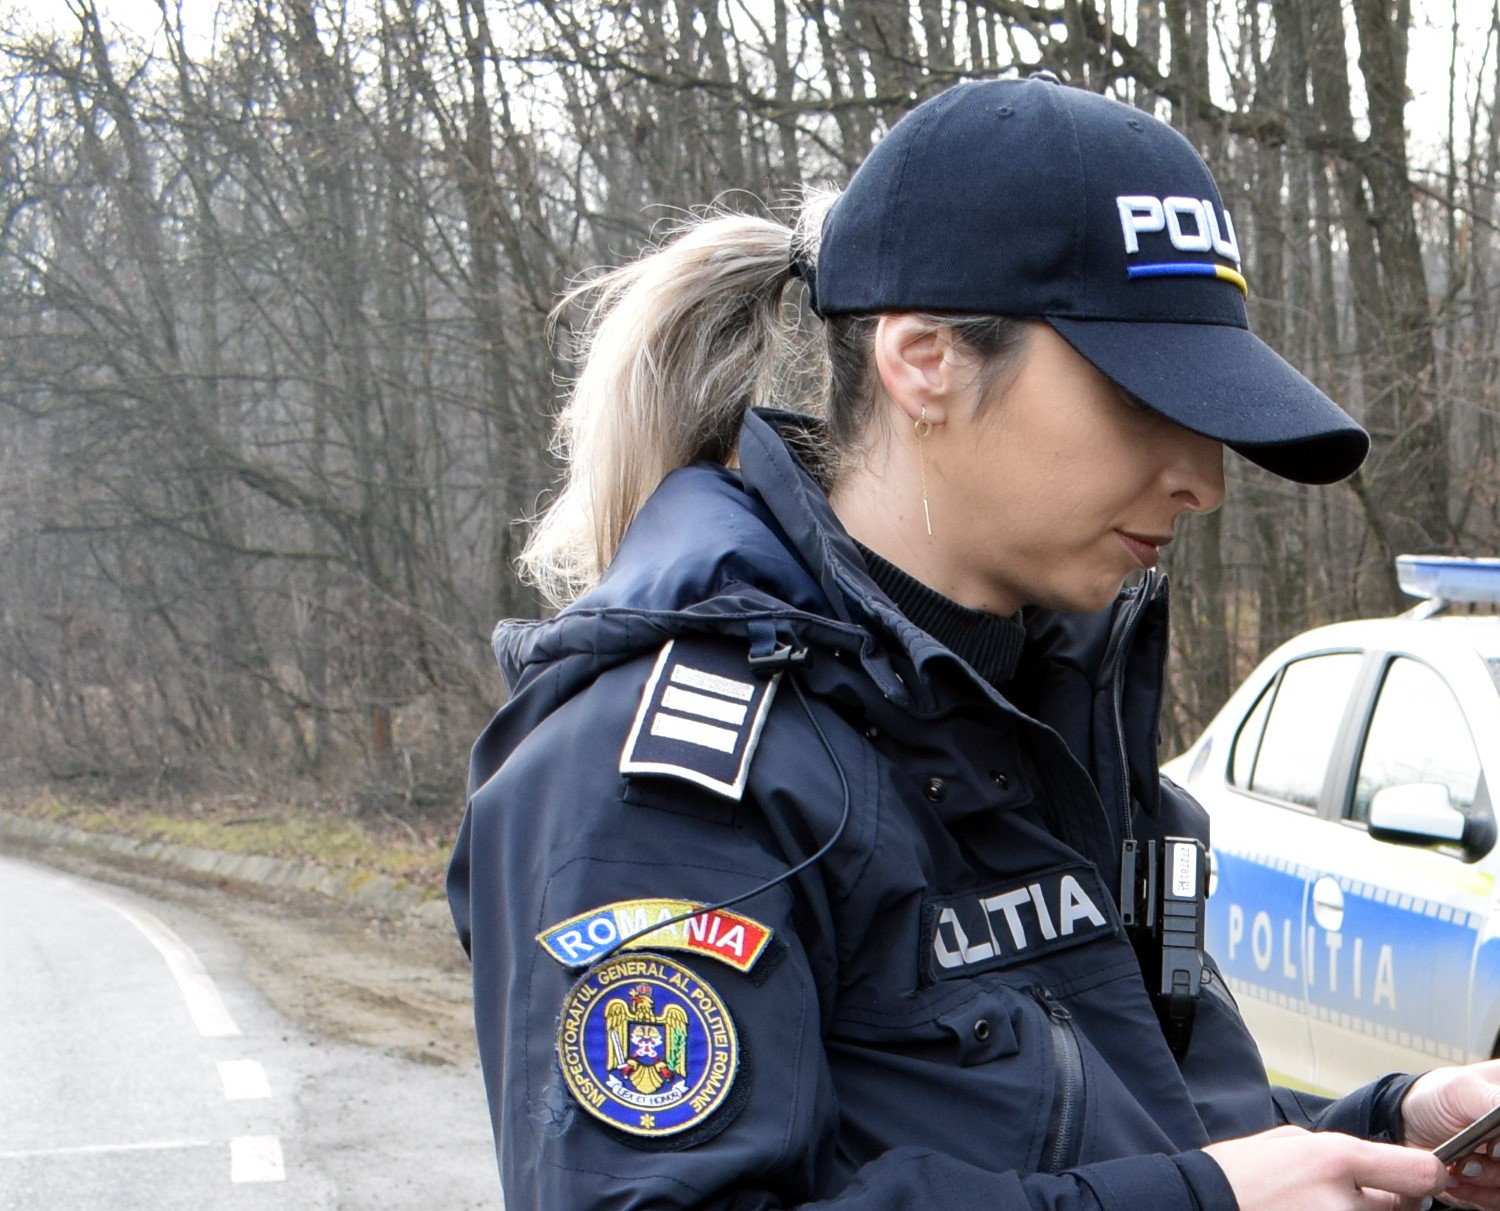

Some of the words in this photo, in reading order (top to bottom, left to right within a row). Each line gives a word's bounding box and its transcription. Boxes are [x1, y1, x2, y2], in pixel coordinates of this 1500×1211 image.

[556, 907, 746, 958] ROMANIA
[1228, 904, 1397, 1010] POLITIA
[564, 983, 607, 1108] INSPECTORATUL
[597, 961, 669, 985] GENERAL
[669, 972, 691, 993] AL
[616, 1087, 633, 1101] LEX
[649, 1090, 680, 1105] HONOR
